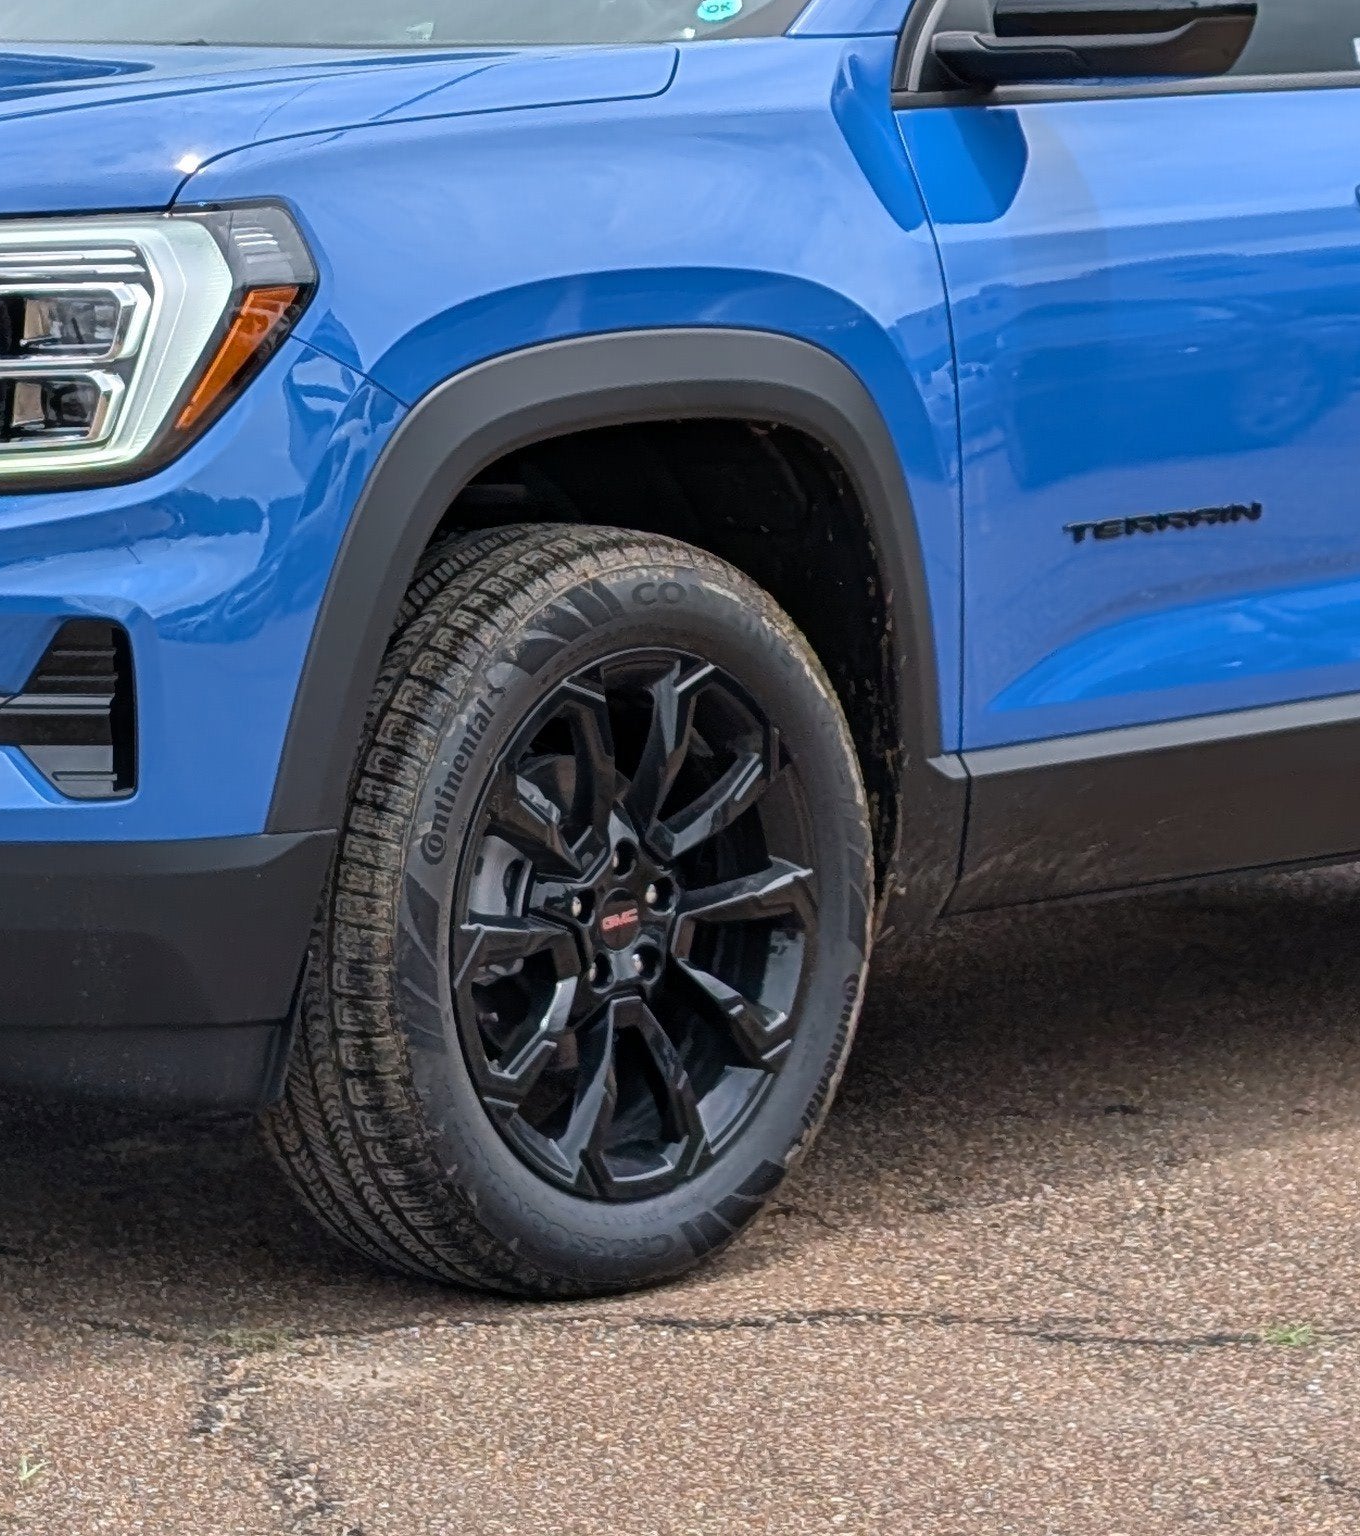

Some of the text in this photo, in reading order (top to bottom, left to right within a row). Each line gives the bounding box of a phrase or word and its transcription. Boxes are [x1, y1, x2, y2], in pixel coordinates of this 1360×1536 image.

[706, 1, 731, 14] OK
[1062, 501, 1262, 544] TERRAIN
[420, 698, 496, 866] Continental
[602, 908, 638, 930] GMC
